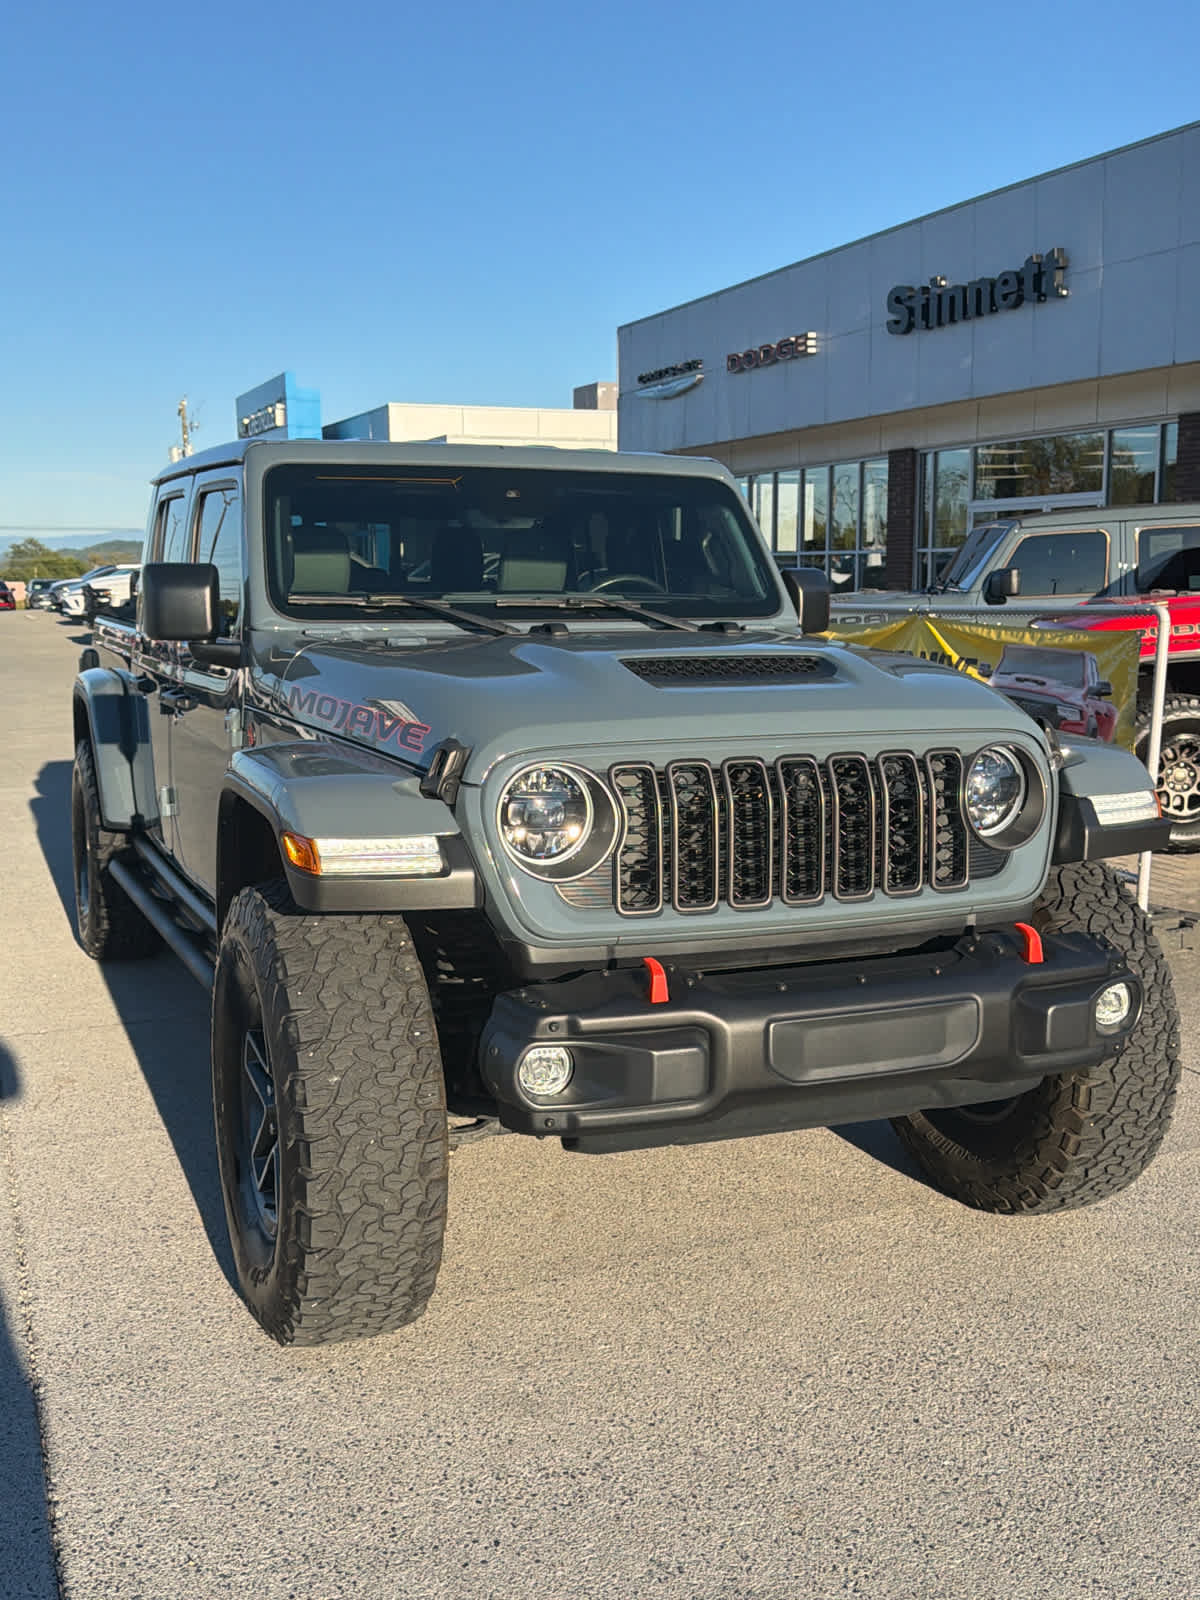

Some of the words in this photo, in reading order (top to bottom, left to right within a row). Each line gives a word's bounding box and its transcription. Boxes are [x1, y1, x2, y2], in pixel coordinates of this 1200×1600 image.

[887, 247, 1069, 335] Stinnett
[726, 331, 817, 373] DODGE
[288, 685, 432, 753] MOJAVE
